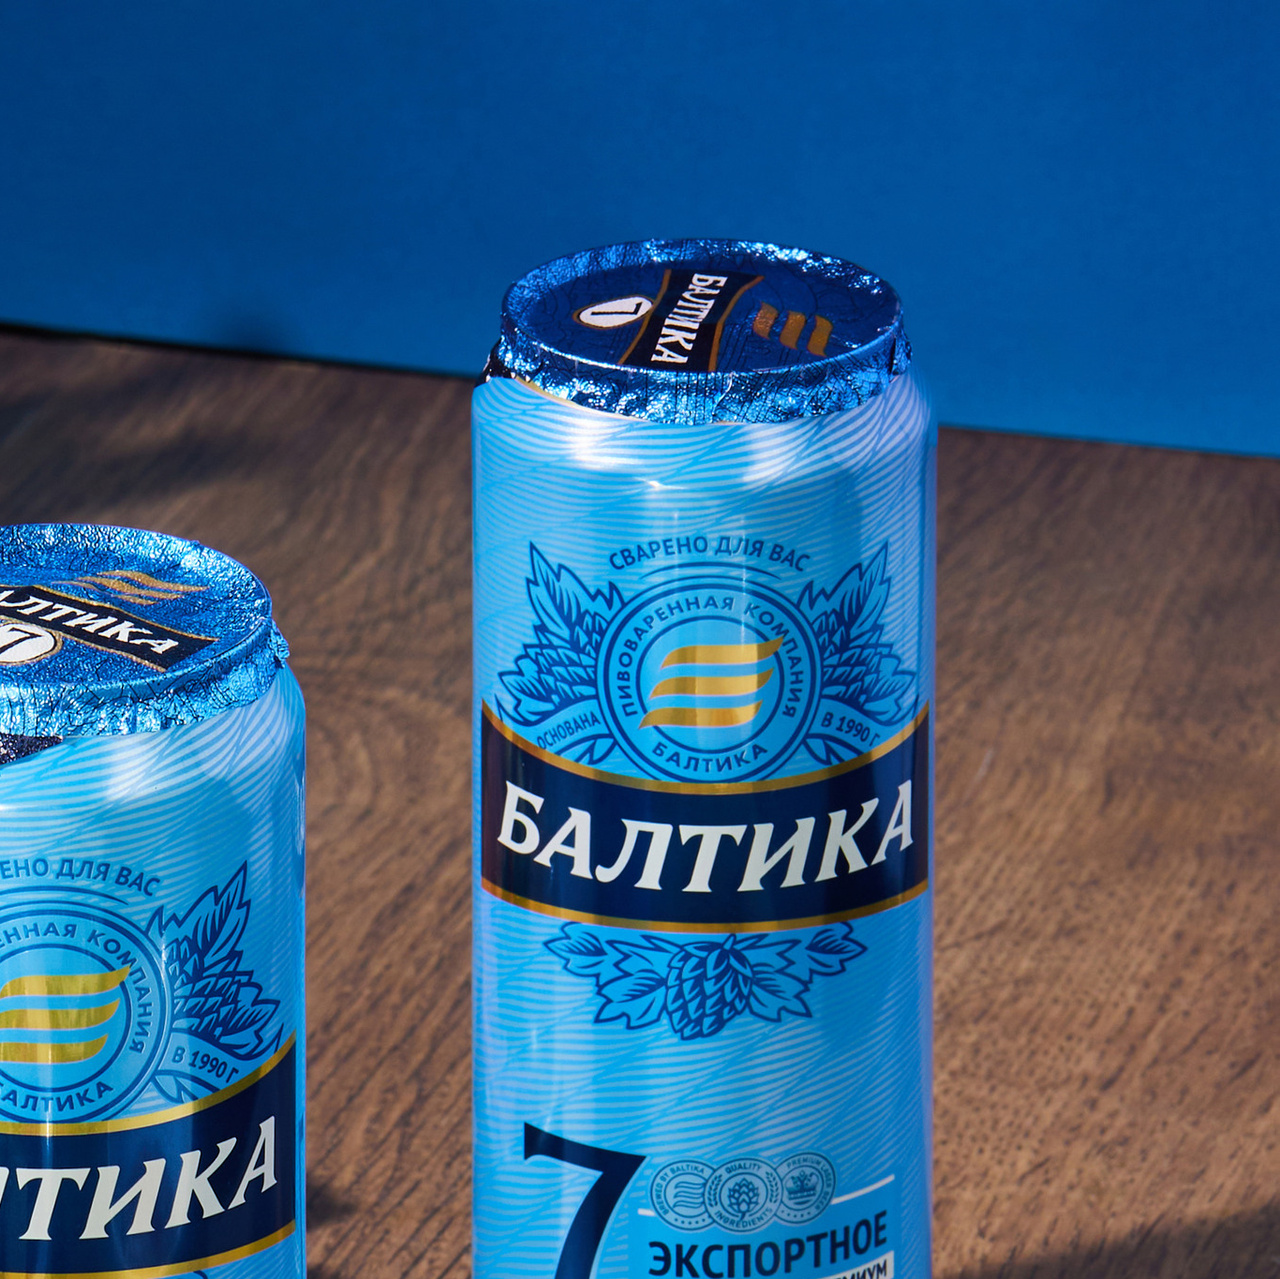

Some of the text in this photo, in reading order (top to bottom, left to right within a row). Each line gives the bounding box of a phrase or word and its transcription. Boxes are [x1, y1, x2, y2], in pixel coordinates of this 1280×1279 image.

[590, 302, 643, 316] 7
[651, 273, 728, 365] БАЛТИКА
[609, 536, 810, 571] СВАРЕНО ДЛЯ ВАС
[617, 595, 804, 718] ПИВОВАРЕННАЯ КОМПАНИЯ
[536, 711, 600, 750] ОСНОВАНА
[821, 712, 833, 728] В
[836, 715, 869, 743] 1990
[652, 742, 768, 773] БАЛТИКА
[497, 779, 914, 893] БАЛТИКА
[56, 859, 110, 881] ДЛЯ
[115, 866, 160, 896] ВАС
[87, 929, 153, 1053] КОМПАНИЯ
[172, 1046, 185, 1063] В
[189, 1050, 229, 1079] 1990
[670, 1164, 705, 1175] BALTIKA
[725, 1162, 762, 1174] QUALITY
[714, 1207, 773, 1229] INGREDIENTS
[648, 1210, 887, 1279] ЭКСПОРТНОЕ
